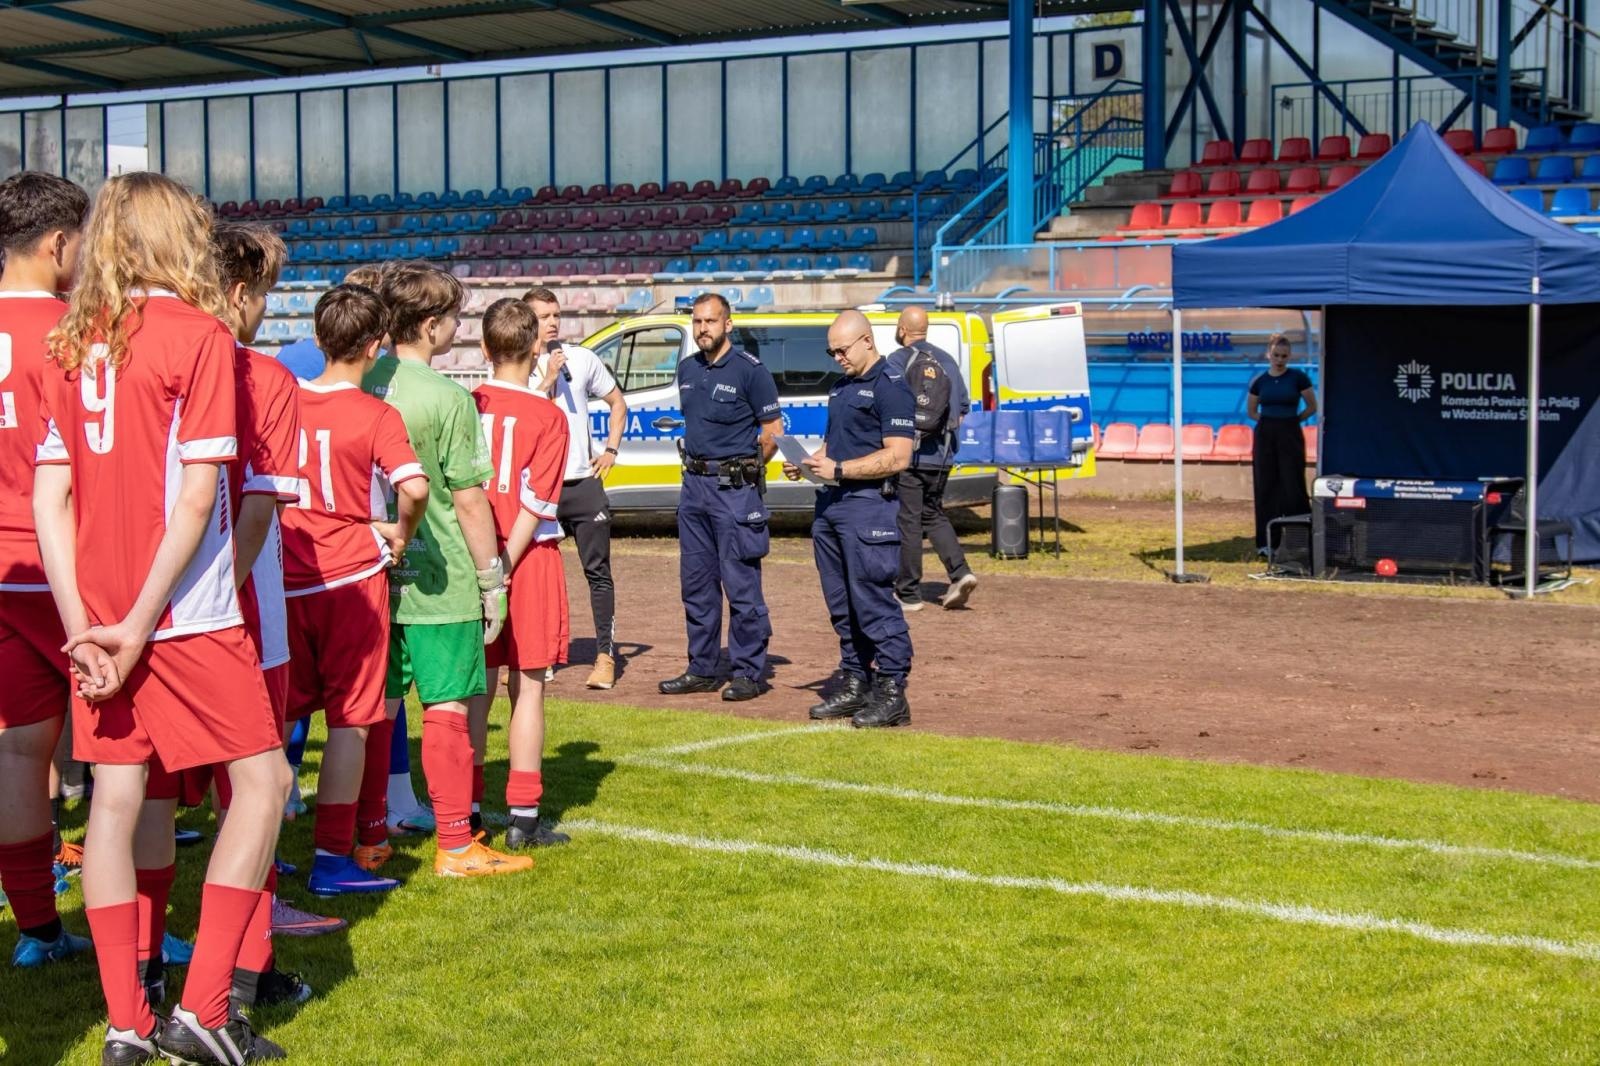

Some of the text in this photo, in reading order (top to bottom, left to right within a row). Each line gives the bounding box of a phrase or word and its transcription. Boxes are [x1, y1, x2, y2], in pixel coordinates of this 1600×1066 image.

[1095, 44, 1122, 78] D
[1127, 332, 1233, 352] GOSPDARZE
[1441, 373, 1516, 391] POLICJA
[81, 343, 116, 455] 9
[1441, 395, 1580, 410] Komenda Powiata Policji
[891, 418, 914, 427] POLICJA
[1441, 409, 1560, 421] w Wodzisławiu Śkim
